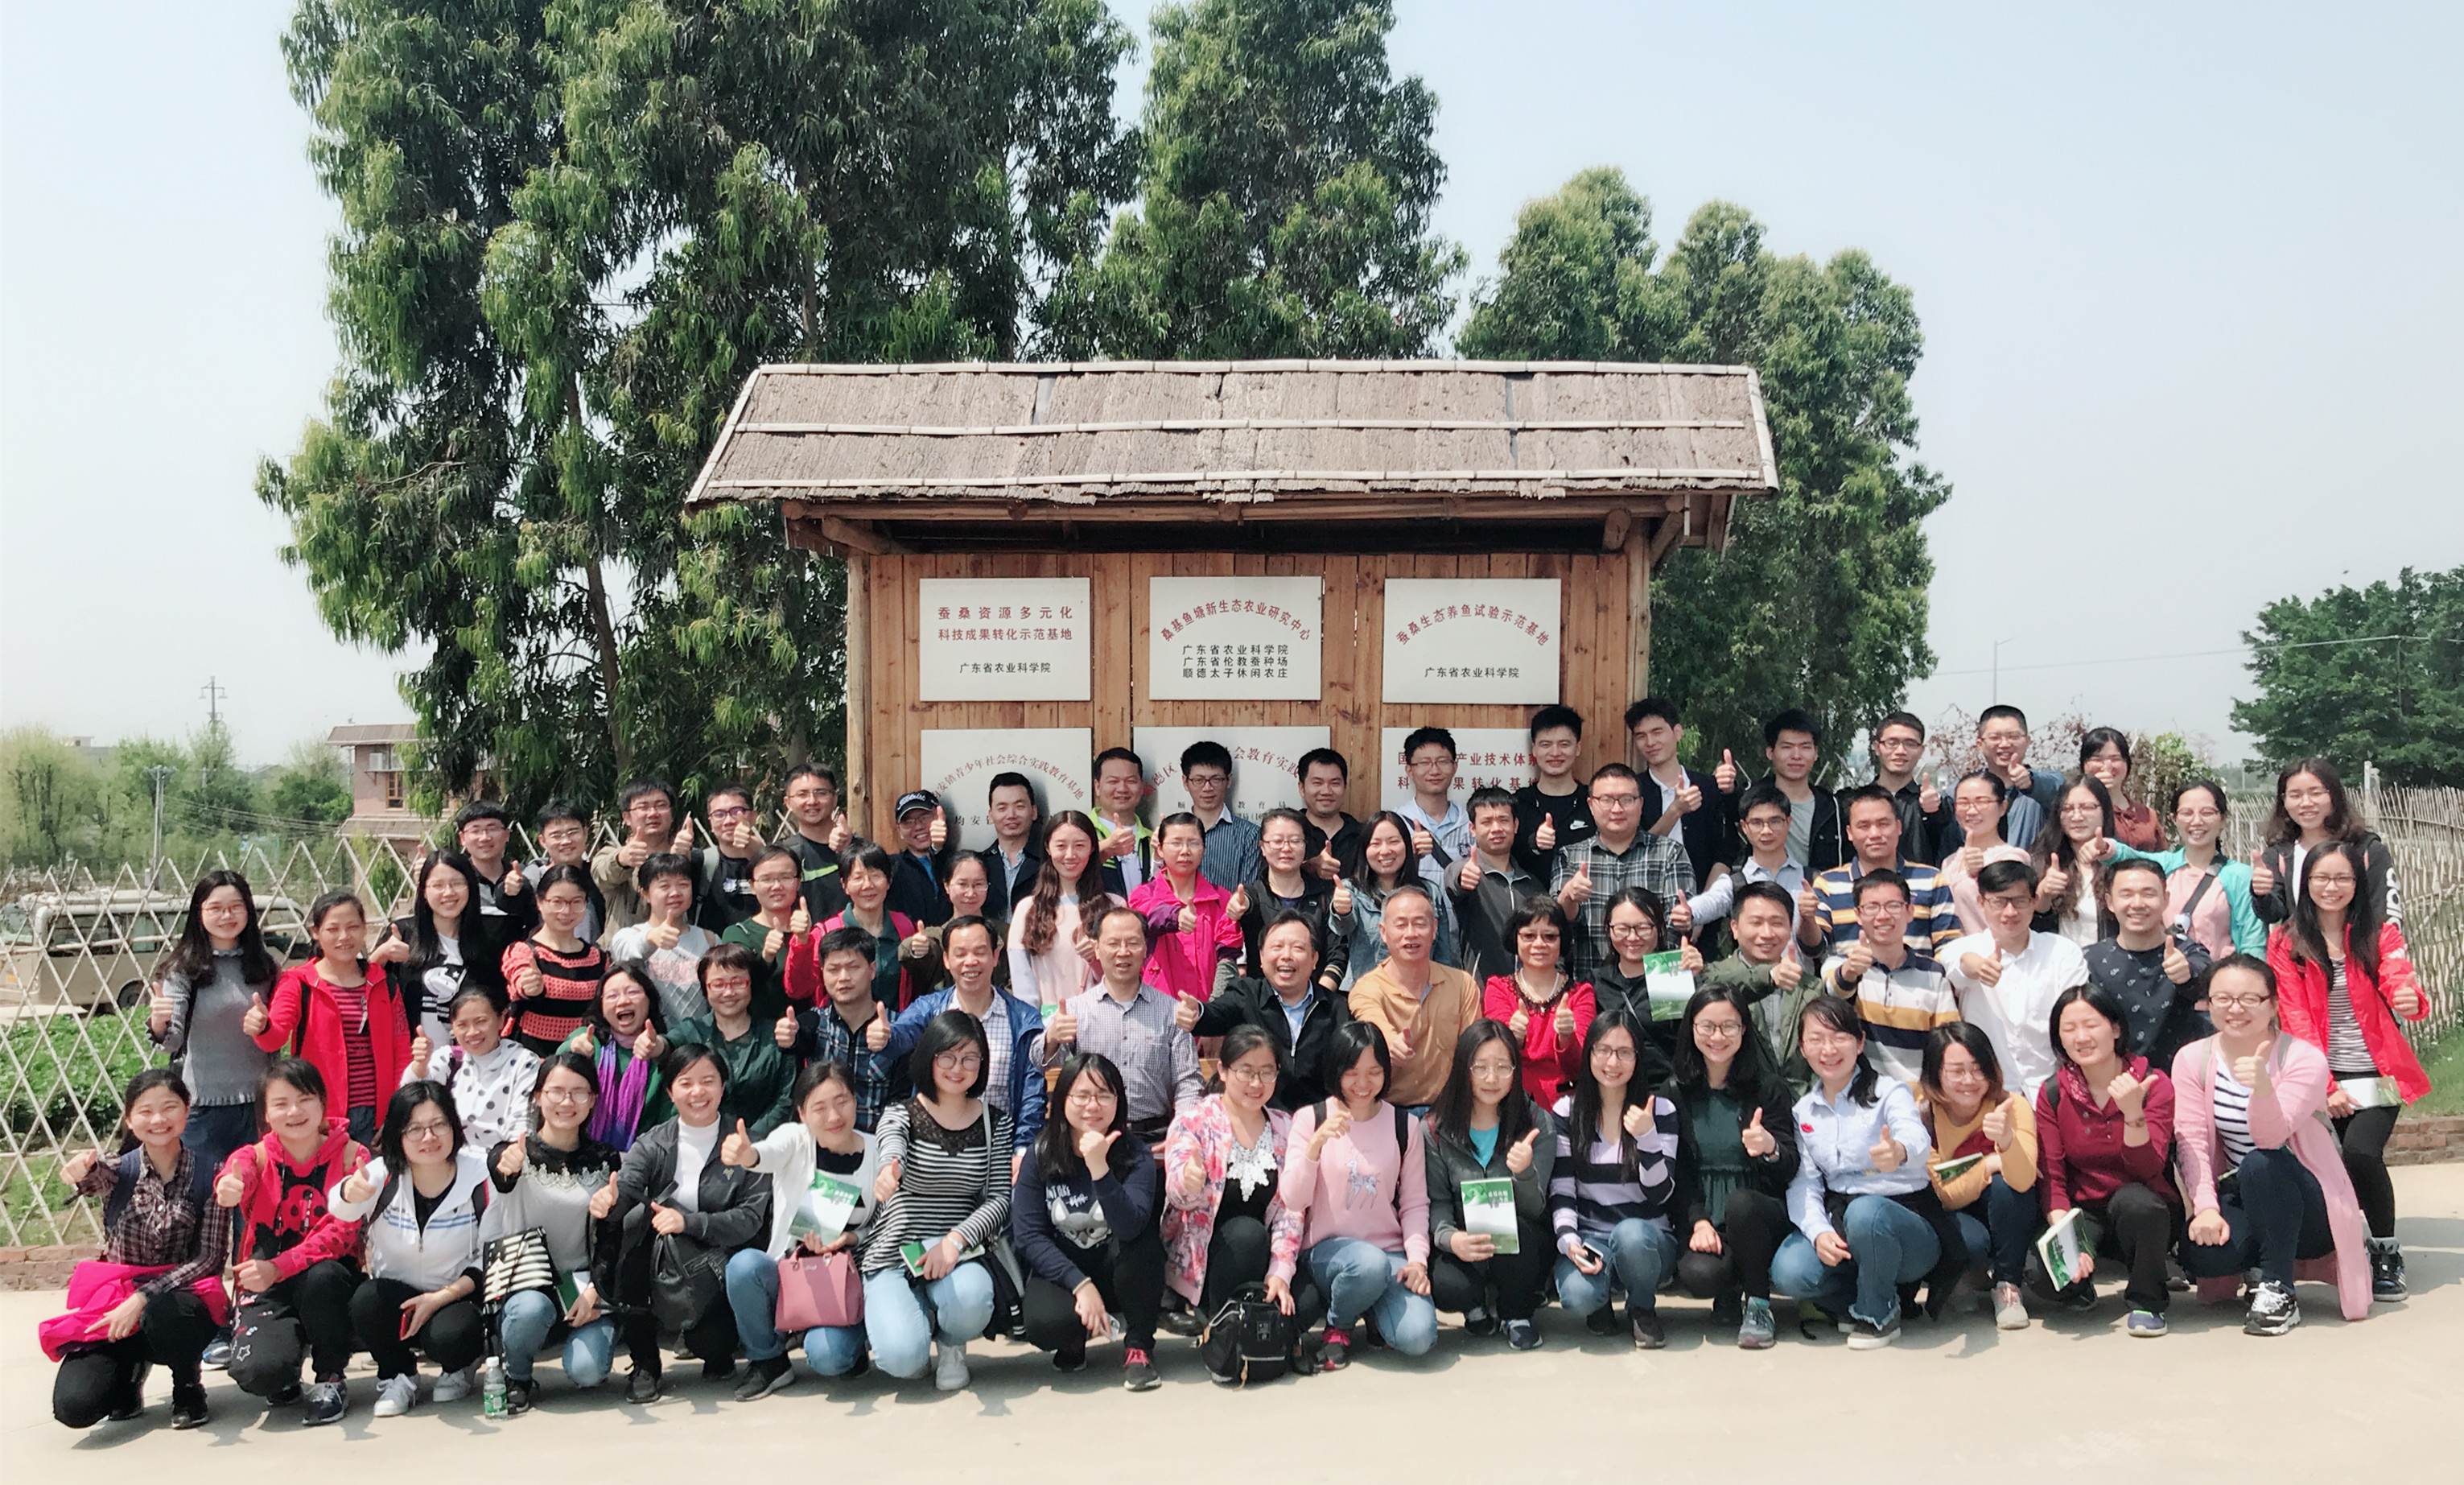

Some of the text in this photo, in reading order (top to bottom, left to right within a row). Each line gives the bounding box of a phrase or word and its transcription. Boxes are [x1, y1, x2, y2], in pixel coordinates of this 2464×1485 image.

[938, 607, 1073, 620] 蚕桑资源多元化
[1160, 599, 1310, 641] 桑基鱼塘新生态农业研究中心
[1396, 604, 1549, 646] 蚕桑生态养鱼试验示范基地
[938, 629, 1073, 641] 科技成果转化示范基地
[1182, 645, 1288, 655] 广东省农业科学院
[1183, 657, 1288, 666] 广东省伦教蚕种场
[959, 662, 1051, 674] 广东省农业科学院
[1182, 668, 1288, 679] 顺德太子休闲农庄
[1424, 667, 1519, 679] 广东省农业科学院
